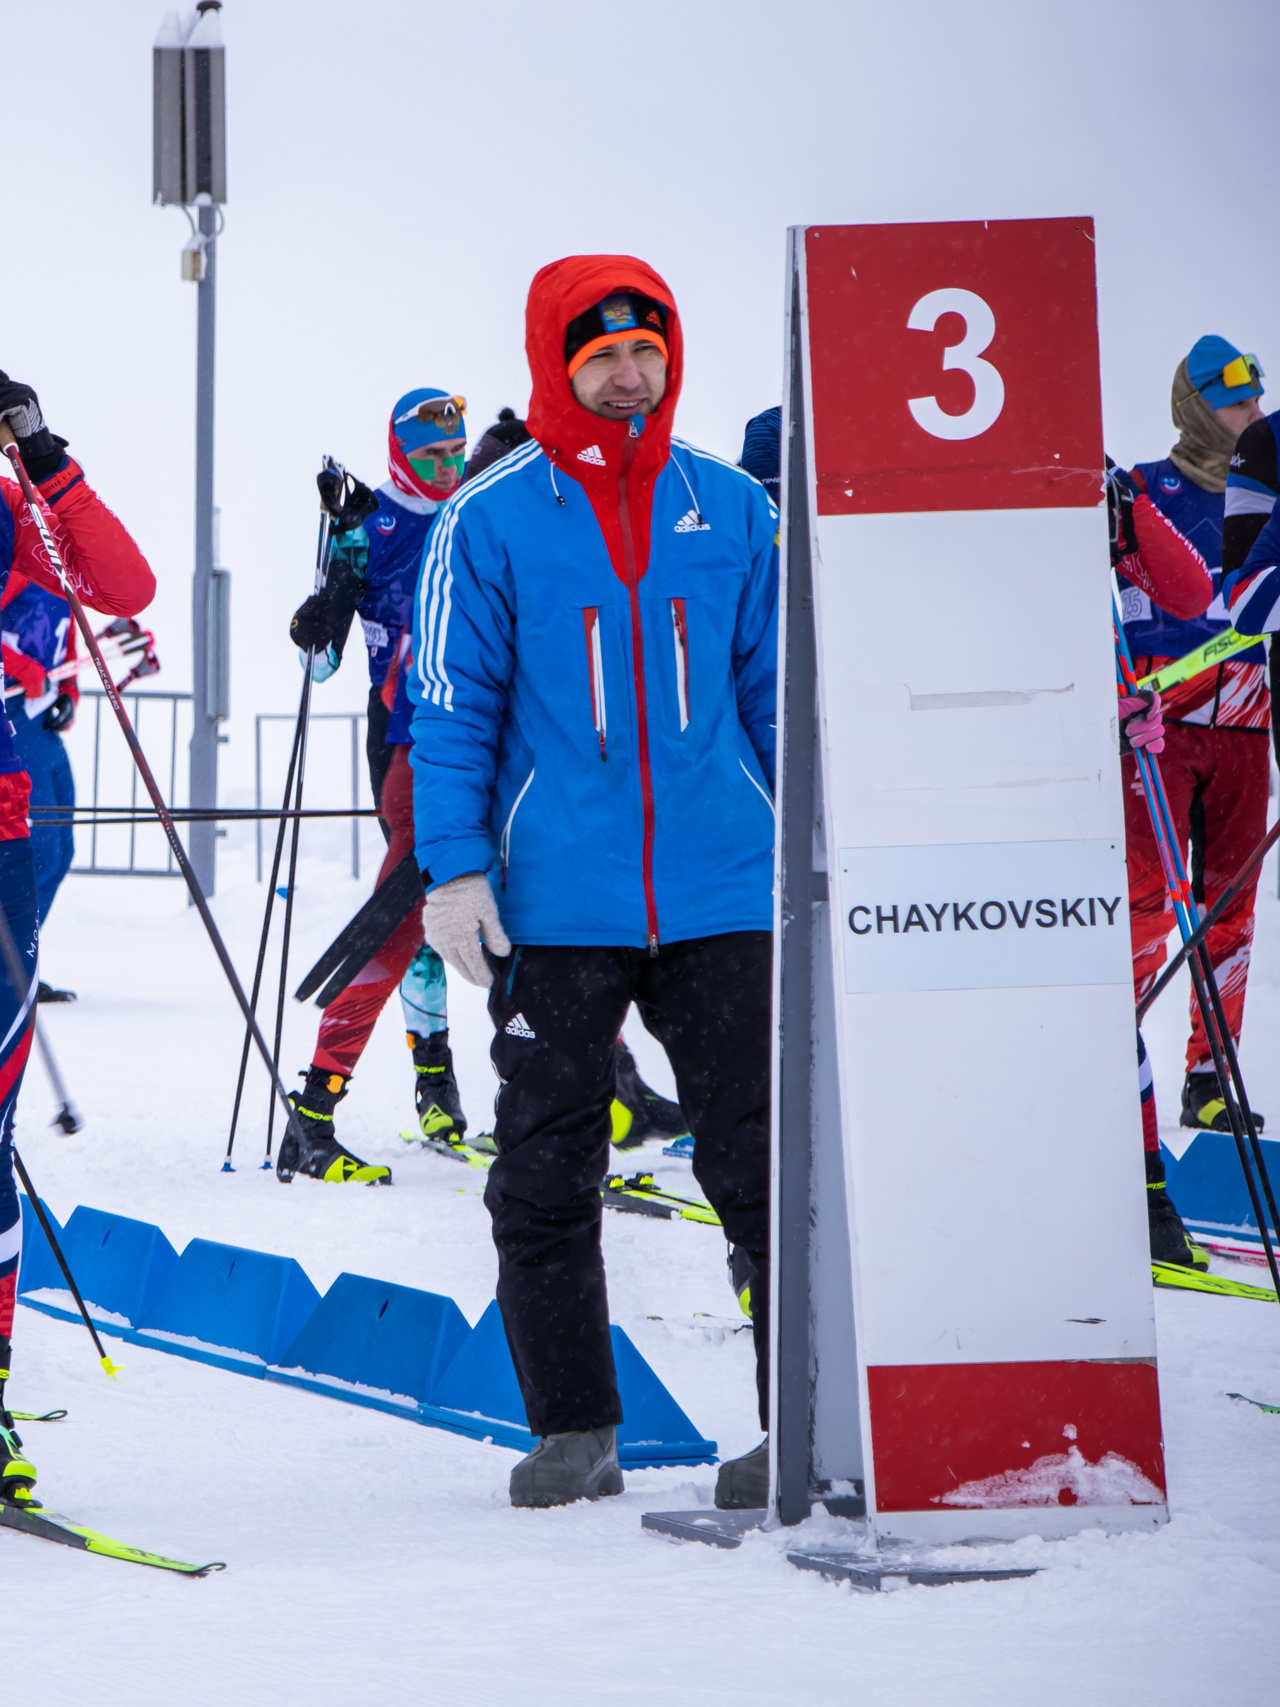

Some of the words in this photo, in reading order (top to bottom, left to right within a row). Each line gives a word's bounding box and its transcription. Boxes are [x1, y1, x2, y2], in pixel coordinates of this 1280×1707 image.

[906, 288, 1005, 441] 3
[577, 453, 606, 467] adidas
[674, 523, 711, 533] adidas
[848, 896, 1122, 935] CHAYKOVSKIY
[505, 1026, 536, 1039] adidas
